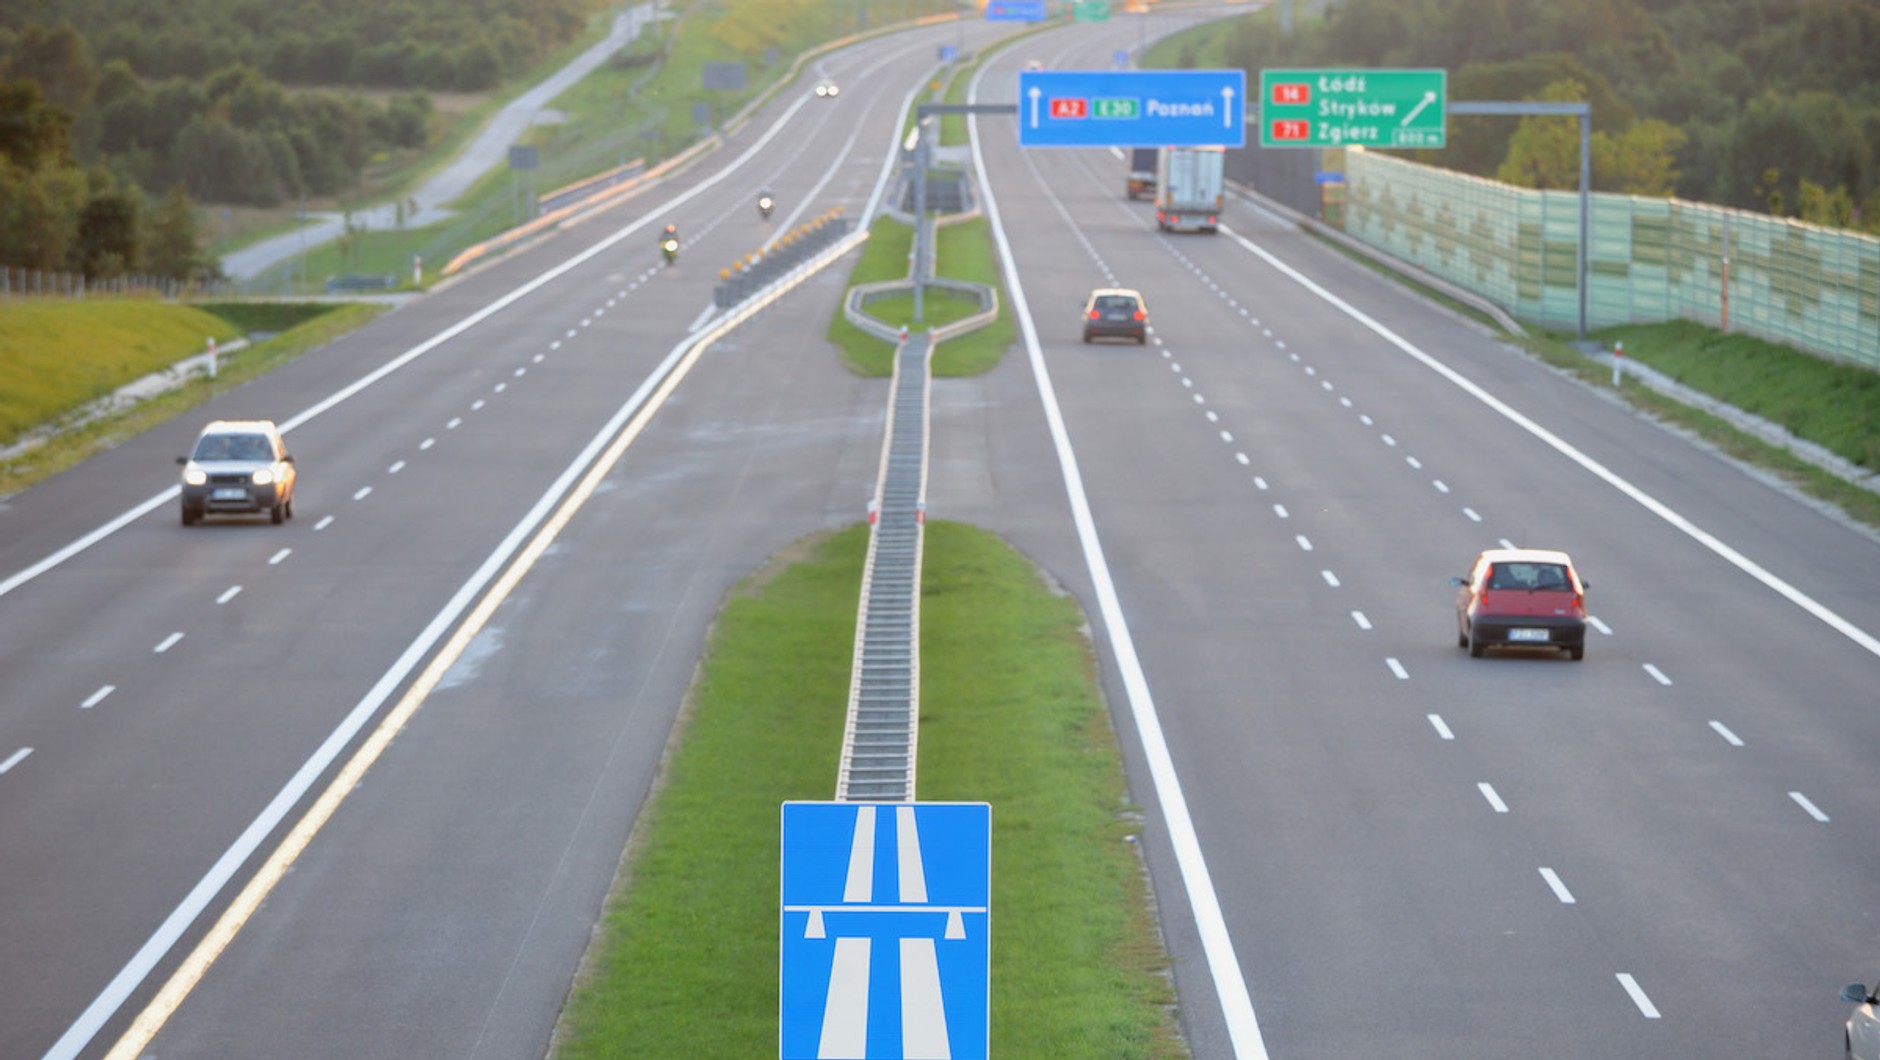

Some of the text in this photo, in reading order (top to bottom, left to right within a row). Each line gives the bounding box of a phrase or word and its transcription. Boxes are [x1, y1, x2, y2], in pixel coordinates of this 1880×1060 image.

[1318, 76, 1366, 92] Łódź
[1282, 87, 1299, 101] 14
[1058, 99, 1214, 117] A2 E30 Poznań
[1318, 99, 1396, 119] Stryków
[1282, 123, 1300, 136] 71
[1318, 122, 1378, 144] Zgierz
